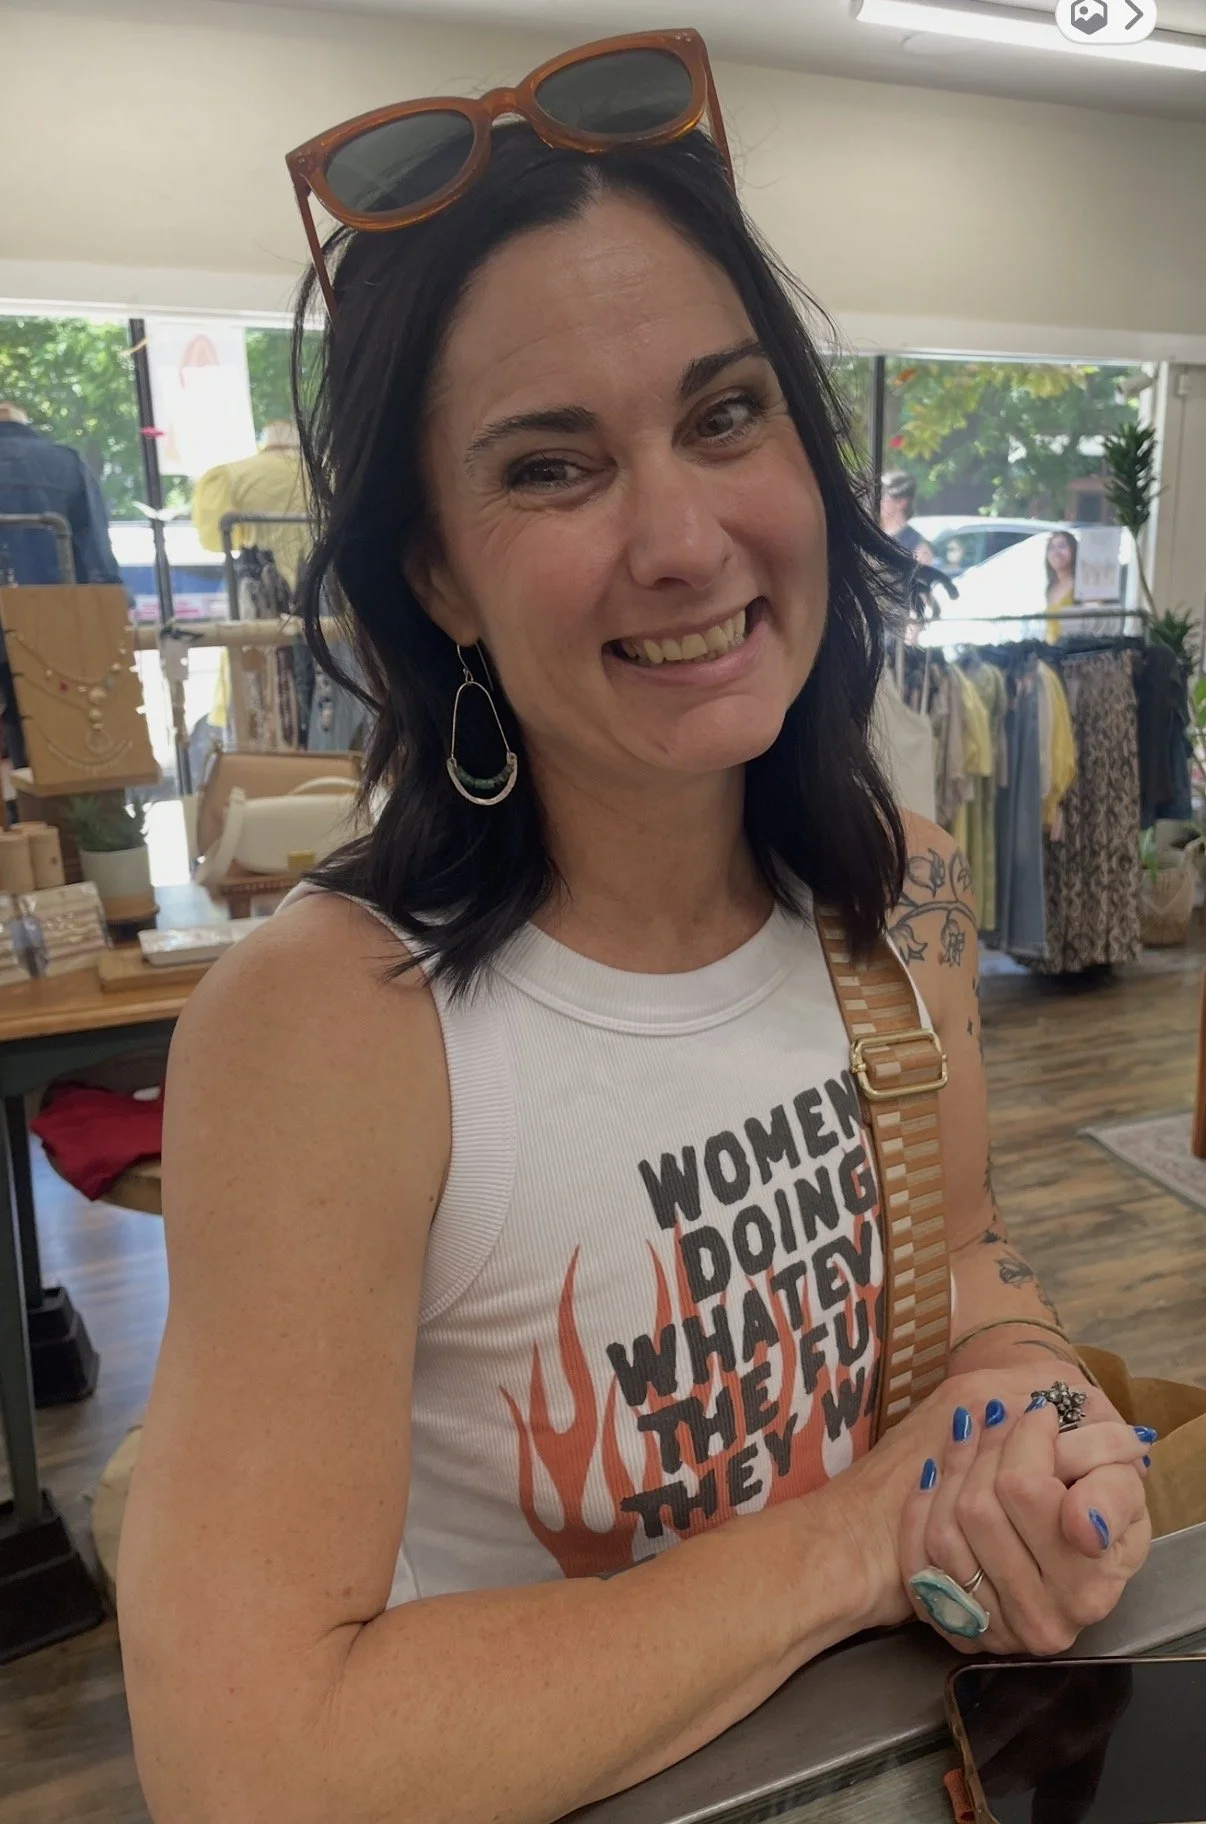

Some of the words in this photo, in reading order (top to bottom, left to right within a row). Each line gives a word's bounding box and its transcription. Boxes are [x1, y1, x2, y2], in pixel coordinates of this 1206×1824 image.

[638, 1069, 863, 1230] WOMEN
[680, 1144, 878, 1302] DOING
[606, 1213, 884, 1405] WHATEV
[620, 1412, 798, 1538] THEY
[637, 1362, 778, 1474] THE
